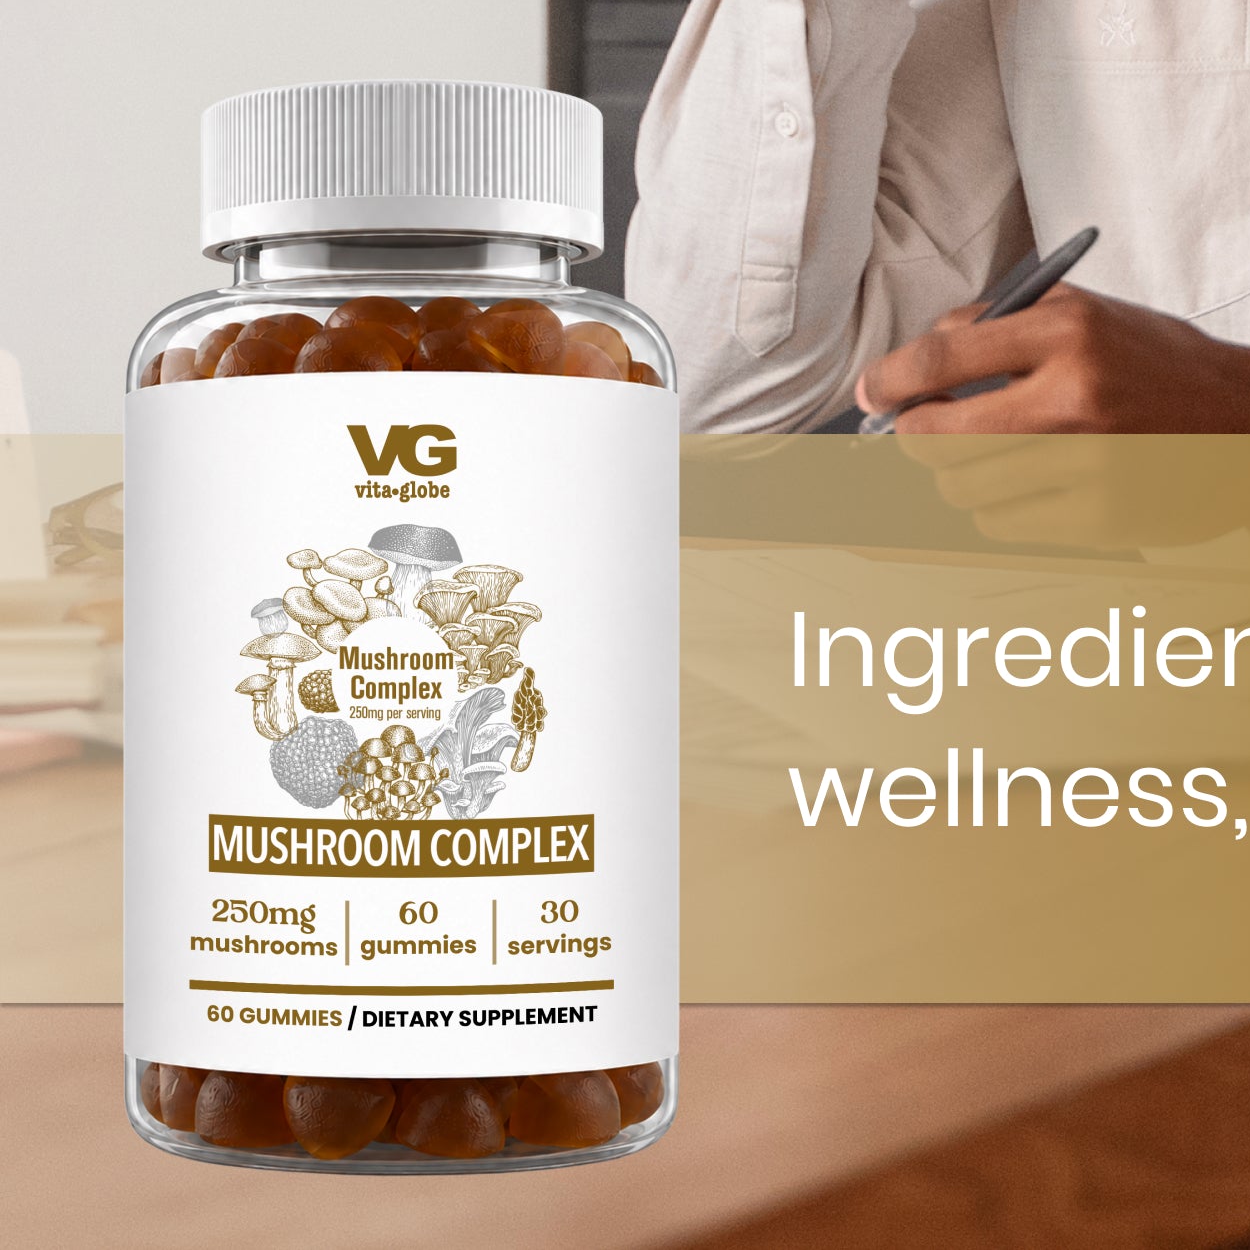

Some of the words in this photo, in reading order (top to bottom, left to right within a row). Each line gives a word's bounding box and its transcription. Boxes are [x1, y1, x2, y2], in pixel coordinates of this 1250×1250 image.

[346, 424, 457, 477] VG
[340, 646, 454, 670] Mushroom
[350, 674, 443, 705] Complex
[349, 705, 384, 722] 250mg
[386, 709, 404, 722] per
[406, 706, 441, 722] serving
[213, 824, 420, 867] MUSHROOM
[430, 825, 589, 867] COMPLEX
[210, 898, 317, 935] 250mg
[399, 901, 439, 925] 60
[540, 899, 579, 924] 30
[189, 932, 339, 958] mushrooms
[360, 934, 477, 961] gummies
[507, 933, 612, 958] servings
[207, 1004, 234, 1023] 60
[239, 1007, 343, 1027] GUMMIES
[362, 1010, 455, 1028] DIETARY
[458, 1005, 598, 1027] SUPPLEMENT
